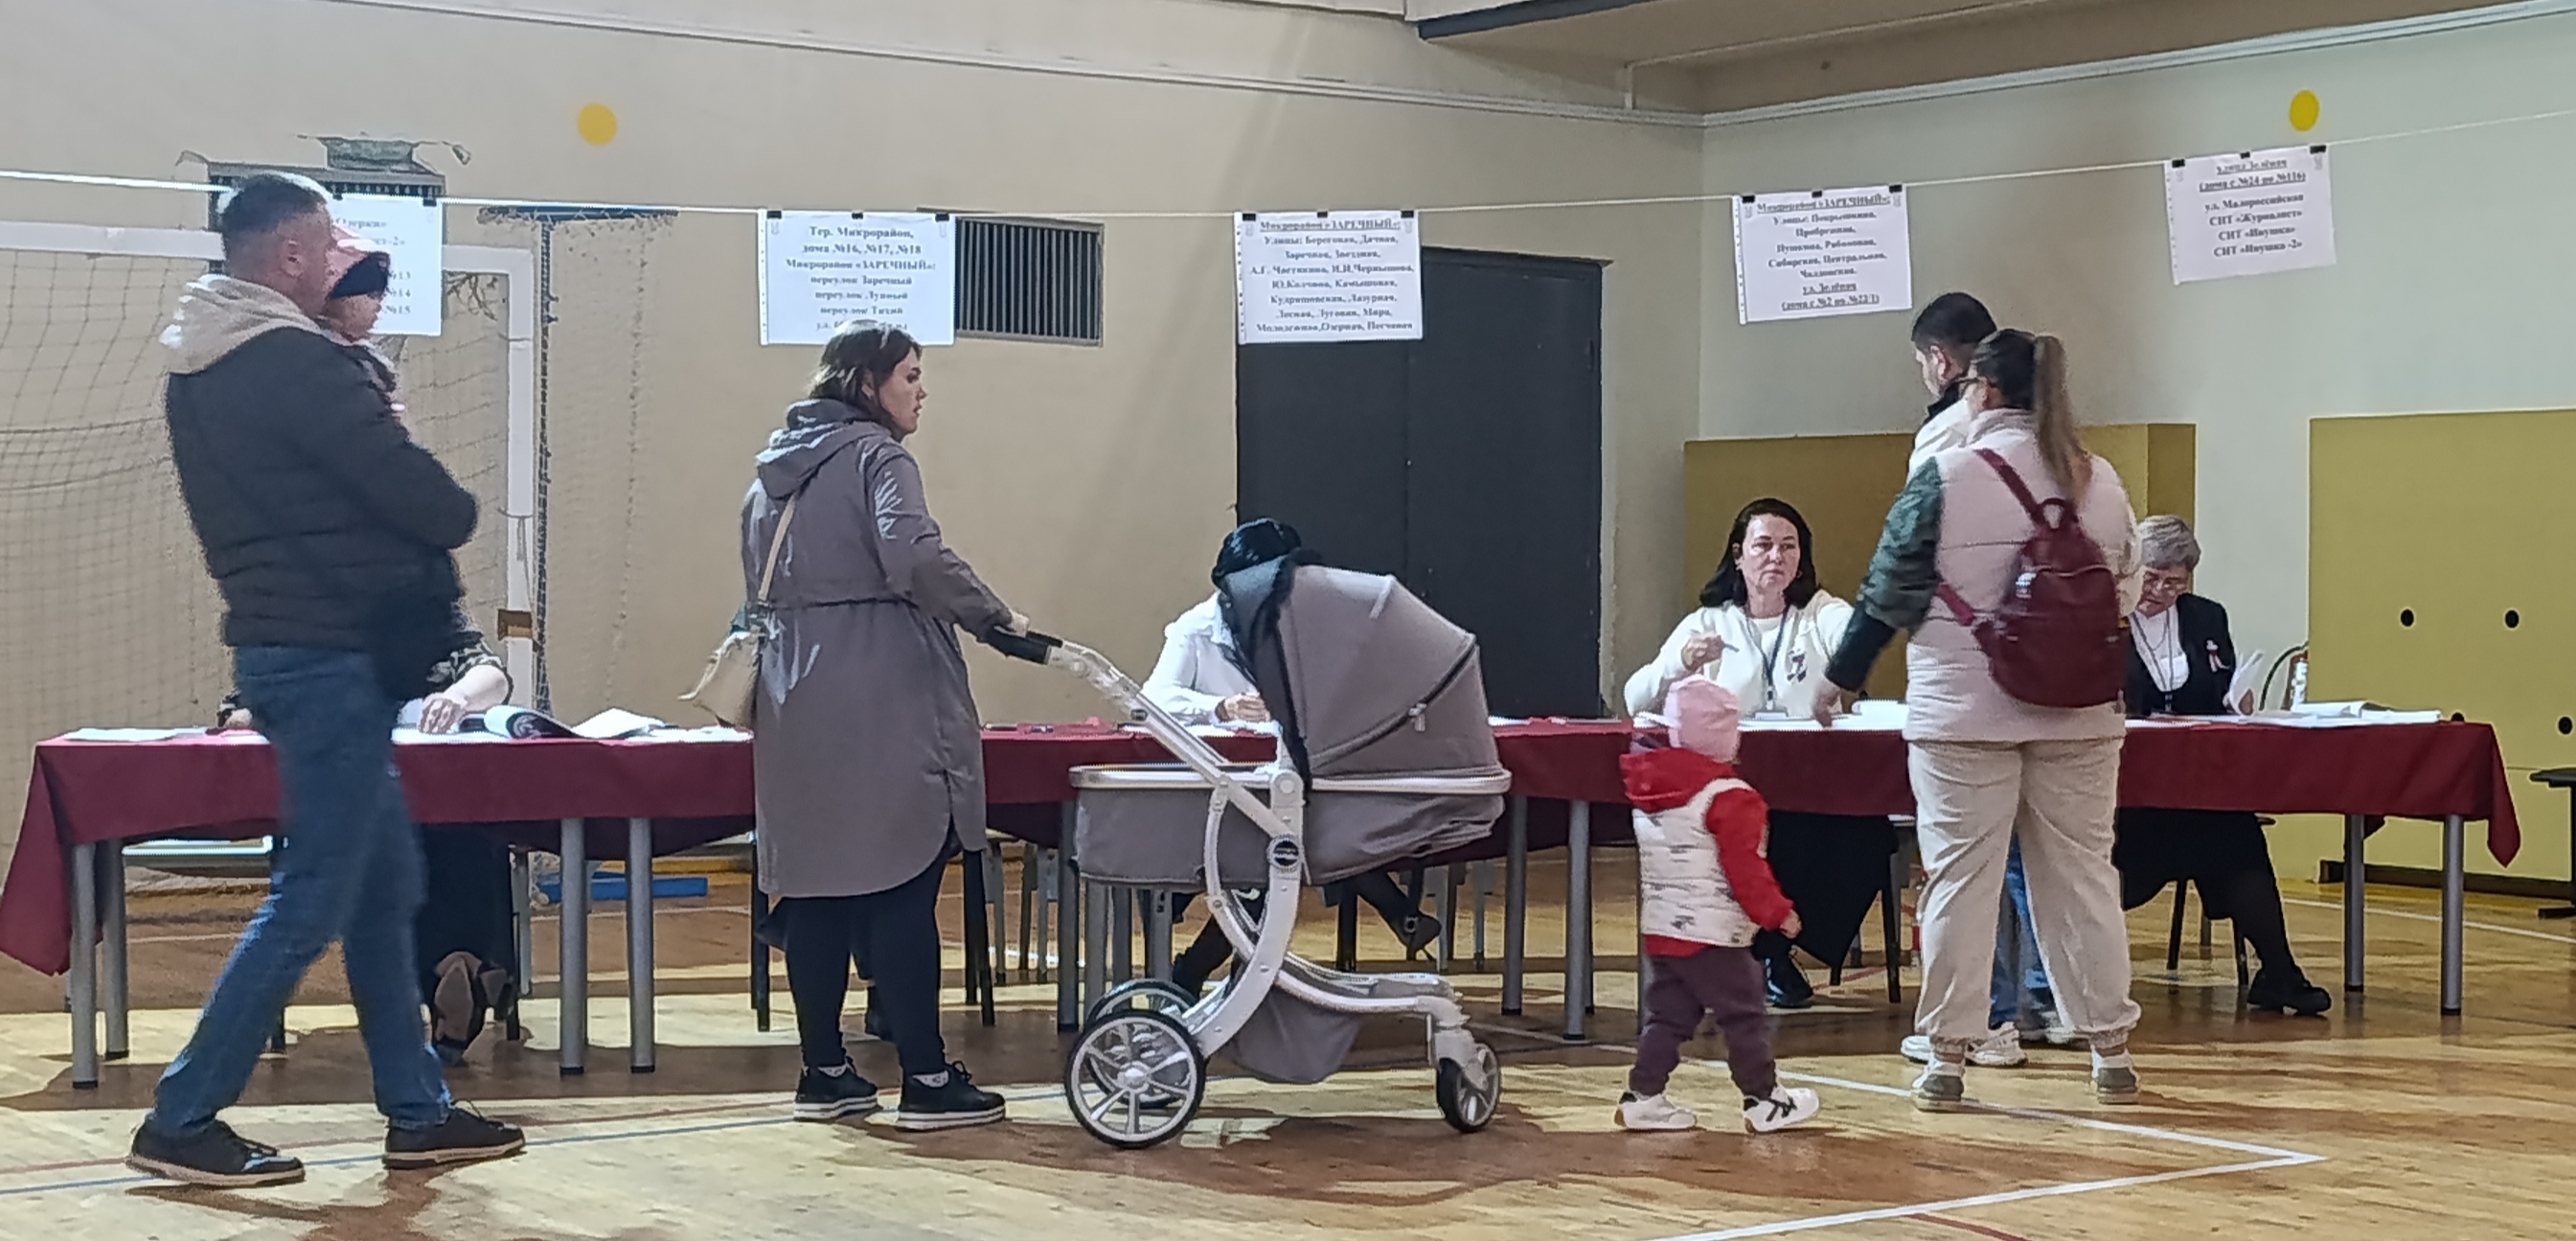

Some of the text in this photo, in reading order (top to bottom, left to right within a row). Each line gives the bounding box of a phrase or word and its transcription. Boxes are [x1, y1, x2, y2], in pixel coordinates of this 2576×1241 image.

[2204, 195, 2304, 213] ул. Малороссийская
[2209, 211, 2302, 226] СНТ «Журналист»
[1260, 221, 1322, 232] Микрорайон
[809, 226, 914, 240] Тер. Микрорайон,
[2219, 226, 2295, 241] СНТ «Ивушка»
[1265, 234, 1399, 246] Улицы: Береговая, Дачная,
[802, 243, 922, 256] дома №16, №17, №18
[2213, 245, 2237, 257] СНТ
[2240, 242, 2286, 254] «Ивушка
[1286, 251, 1332, 261] Заречная,
[786, 259, 853, 271] Микрорайон
[810, 275, 912, 287] переулок Заречный
[815, 290, 909, 303] переулок Лунный
[820, 305, 903, 316] переулок Тихий
[1276, 309, 1315, 319] Лесная,
